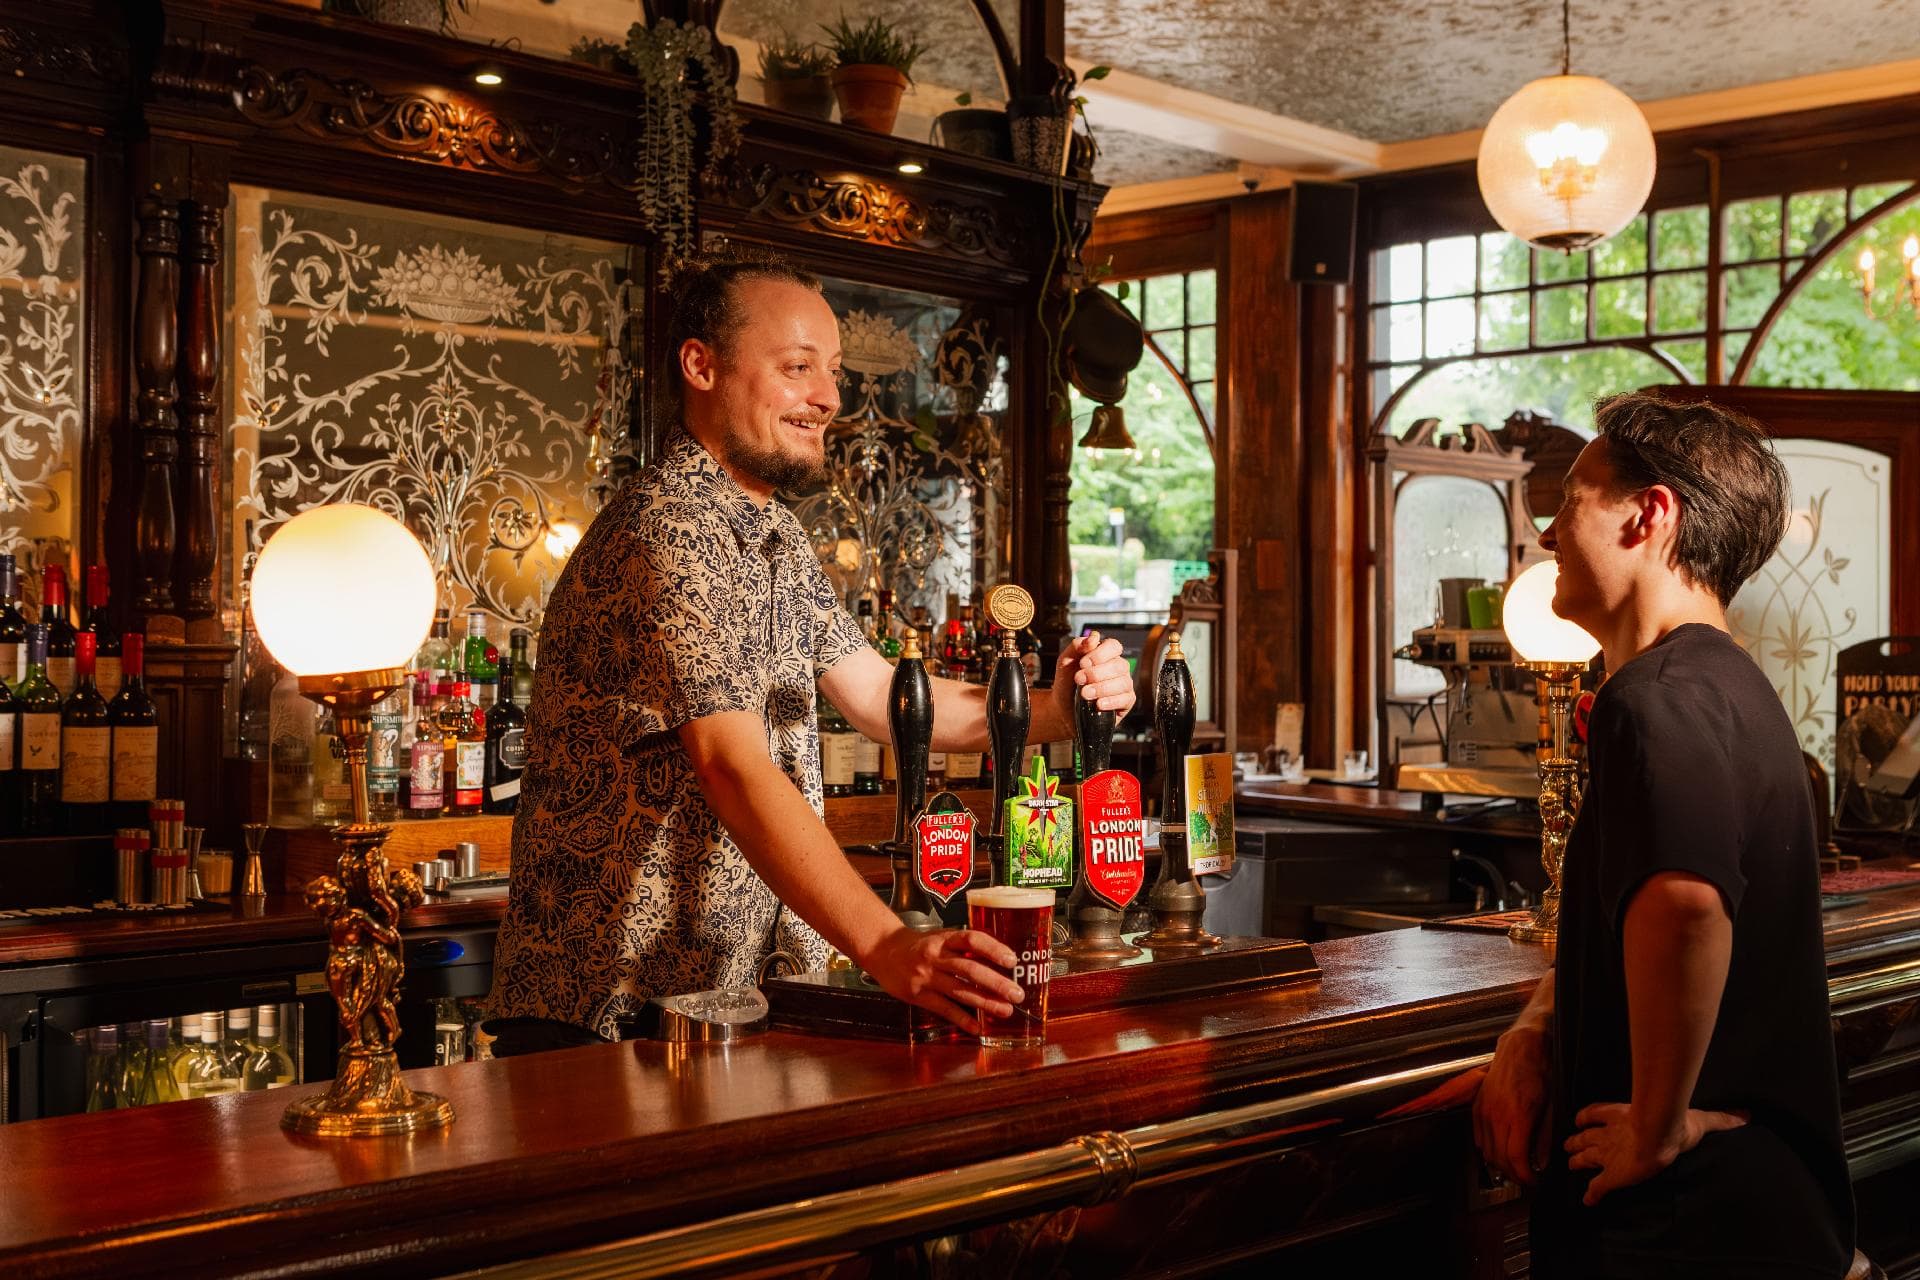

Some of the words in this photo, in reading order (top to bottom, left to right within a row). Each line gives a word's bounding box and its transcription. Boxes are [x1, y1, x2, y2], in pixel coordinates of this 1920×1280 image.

[1101, 806, 1131, 816] FULLER'S
[928, 814, 963, 826] FULLER'S
[1090, 819, 1141, 835] LONDON
[923, 828, 969, 846] LONDON
[930, 843, 963, 857] PRIDE
[1091, 836, 1143, 865] PRIDE
[1023, 867, 1063, 879] HOPHEAD
[1014, 963, 1050, 985] PRID
